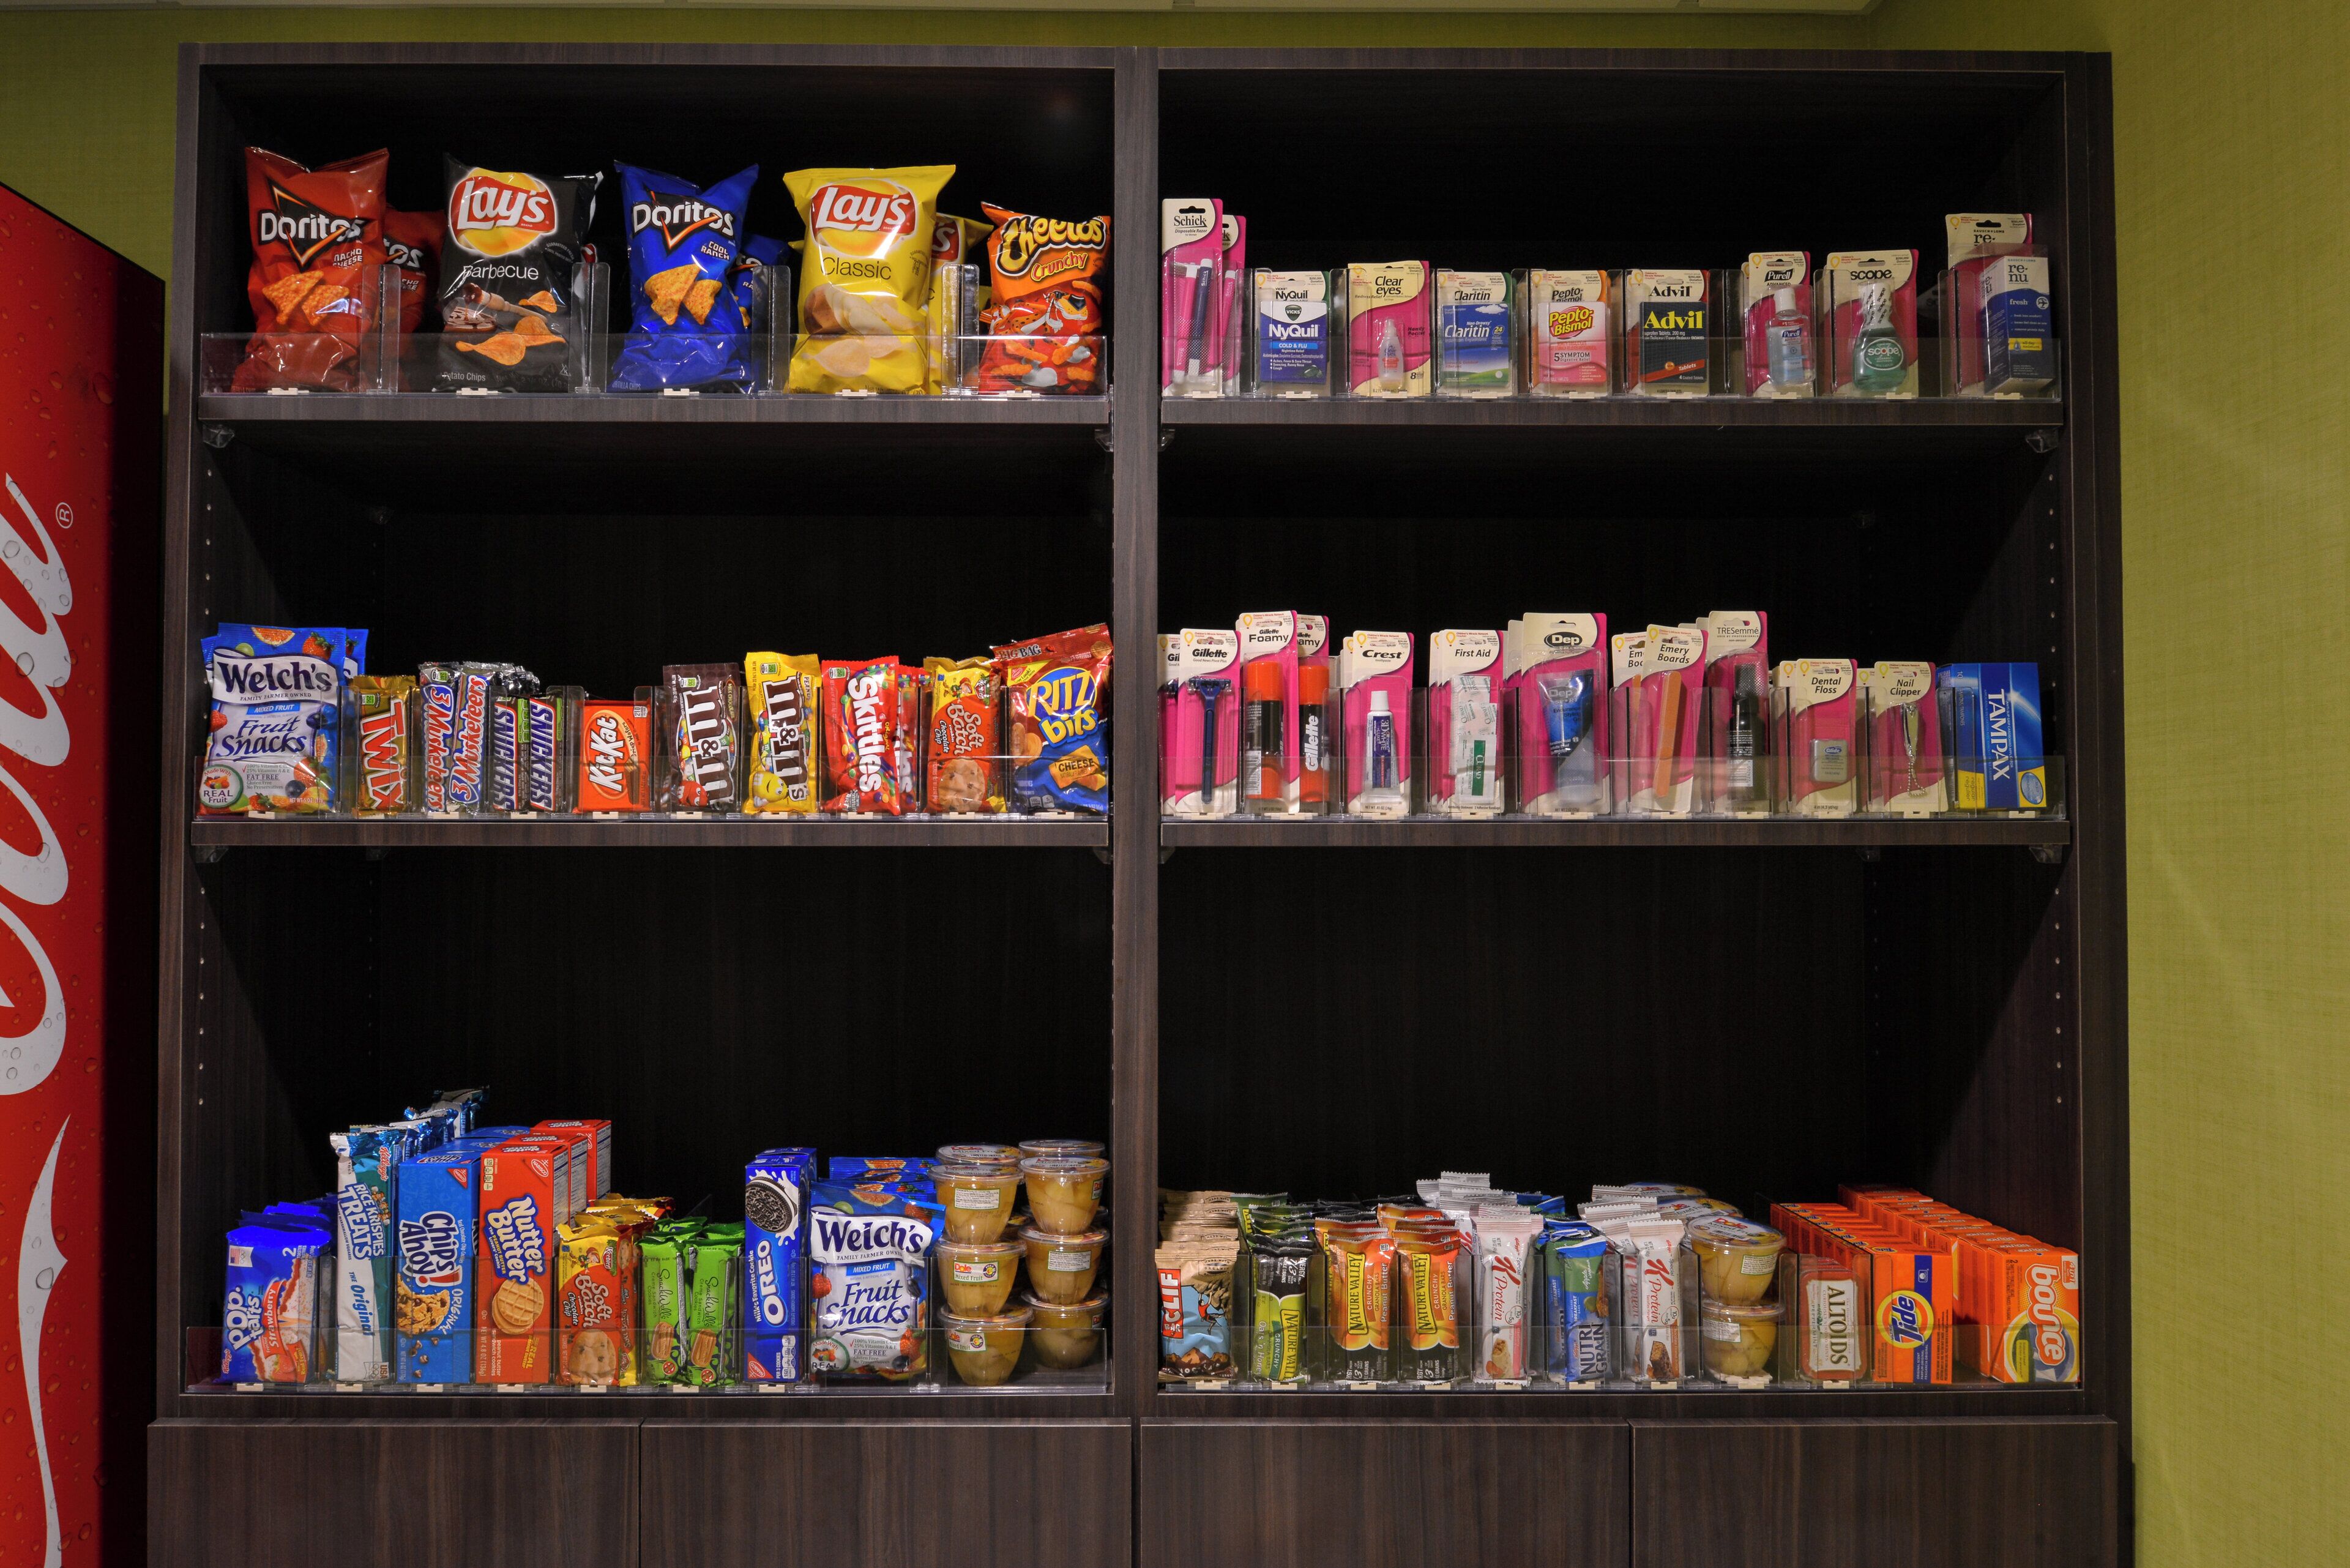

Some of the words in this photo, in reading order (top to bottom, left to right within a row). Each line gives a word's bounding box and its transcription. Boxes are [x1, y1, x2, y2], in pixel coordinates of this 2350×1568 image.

[457, 181, 548, 230] Lay's
[632, 201, 734, 236] Doritos
[816, 186, 911, 231] Lay's
[261, 212, 365, 242] Doritos
[1174, 215, 1207, 228] Schick
[334, 248, 362, 261] NACHO
[701, 245, 729, 260] RANCH
[709, 241, 728, 255] COOL
[999, 216, 1104, 272] Cheetos
[463, 264, 539, 280] Barbecue
[822, 256, 892, 280] Classic
[1031, 252, 1087, 281] Crunchy
[1375, 277, 1403, 286] Clear
[1851, 270, 1892, 280] scope
[2009, 274, 2029, 282] nu
[1275, 291, 1308, 300] NyQuil
[1376, 287, 1401, 297] eyes
[1455, 291, 1490, 300] Claritin
[1649, 286, 1691, 296] Advil
[1269, 324, 1319, 340] NyQuil
[1444, 325, 1490, 337] Claritin
[1554, 315, 1593, 335] Bismol
[1644, 311, 1703, 329] Advil
[1554, 353, 1560, 362] 5
[1868, 346, 1900, 355] scope
[466, 373, 485, 382] Chips
[1020, 644, 1042, 656] BAG
[1192, 649, 1227, 657] Gillette
[1249, 633, 1289, 643] Foamy
[1551, 635, 1580, 645] Dep
[1660, 644, 1689, 655] Emery
[1362, 650, 1402, 659] Crest
[1658, 654, 1690, 663] Boards
[217, 661, 333, 694] Welch's
[1815, 685, 1837, 694] Floss
[1890, 688, 1921, 697] Clipper
[1028, 671, 1091, 717] RITZ
[1549, 689, 1573, 698] Dep
[236, 715, 300, 739] Fruit
[453, 674, 487, 785] Musketeers
[764, 678, 808, 800] m&m's
[848, 677, 885, 793] Skittles
[939, 720, 949, 753] Chocolate
[947, 704, 971, 755] Batch
[963, 712, 984, 749] Soft
[1041, 709, 1097, 744] bits
[1988, 689, 2010, 781] TAMPAX
[216, 731, 307, 758] Snacks
[427, 706, 451, 810] Musketeers
[494, 707, 515, 809] SNICKERS
[531, 704, 554, 808] SNICKERS
[1305, 715, 1319, 771] Gillette
[1058, 758, 1094, 772] CHEESE
[377, 1147, 390, 1181] Kellogg's
[337, 1187, 371, 1259] TREATS
[352, 1184, 372, 1208] RICE
[366, 1208, 385, 1256] KRISPIES
[509, 1197, 544, 1273] Nutter
[425, 1214, 457, 1271] Chips
[487, 1209, 527, 1282] Butter
[493, 1235, 502, 1254] PEANUT
[816, 1219, 923, 1253] Welch's
[283, 1248, 296, 1257] 2
[873, 1263, 890, 1271] FRUIT
[955, 1263, 971, 1272] Dole
[757, 1240, 785, 1324] OREO
[1349, 1255, 1363, 1291] VALLEY
[1414, 1255, 1430, 1290] VALLEY
[1492, 1256, 1521, 1285] K
[1581, 1269, 1591, 1290] Apple
[1644, 1259, 1674, 1286] K
[575, 1275, 599, 1327] Batch
[591, 1283, 612, 1320] Soft
[657, 1269, 673, 1319] SnackWell's
[703, 1277, 718, 1327] SnackWell's
[750, 1274, 758, 1301] Favorite
[841, 1279, 904, 1307] Fruit
[1160, 1272, 1180, 1322] CLIF
[1493, 1276, 1508, 1321] Protein
[1649, 1279, 1662, 1323] Protein
[266, 1289, 280, 1347] Strawberry
[351, 1285, 375, 1336] Original
[568, 1292, 578, 1325] Chocolate
[822, 1301, 910, 1330] Snacks
[1349, 1292, 1365, 1331] NATURE
[1415, 1292, 1433, 1330] NATURE
[1892, 1295, 1923, 1343] Tide
[2031, 1266, 2063, 1361] bounce
[1283, 1313, 1298, 1352] NATURE
[1827, 1285, 1848, 1364] ALTOIDS
[1578, 1325, 1596, 1375] NUTRI
[1592, 1323, 1608, 1373] GRAIN
[379, 1364, 388, 1379] USA
